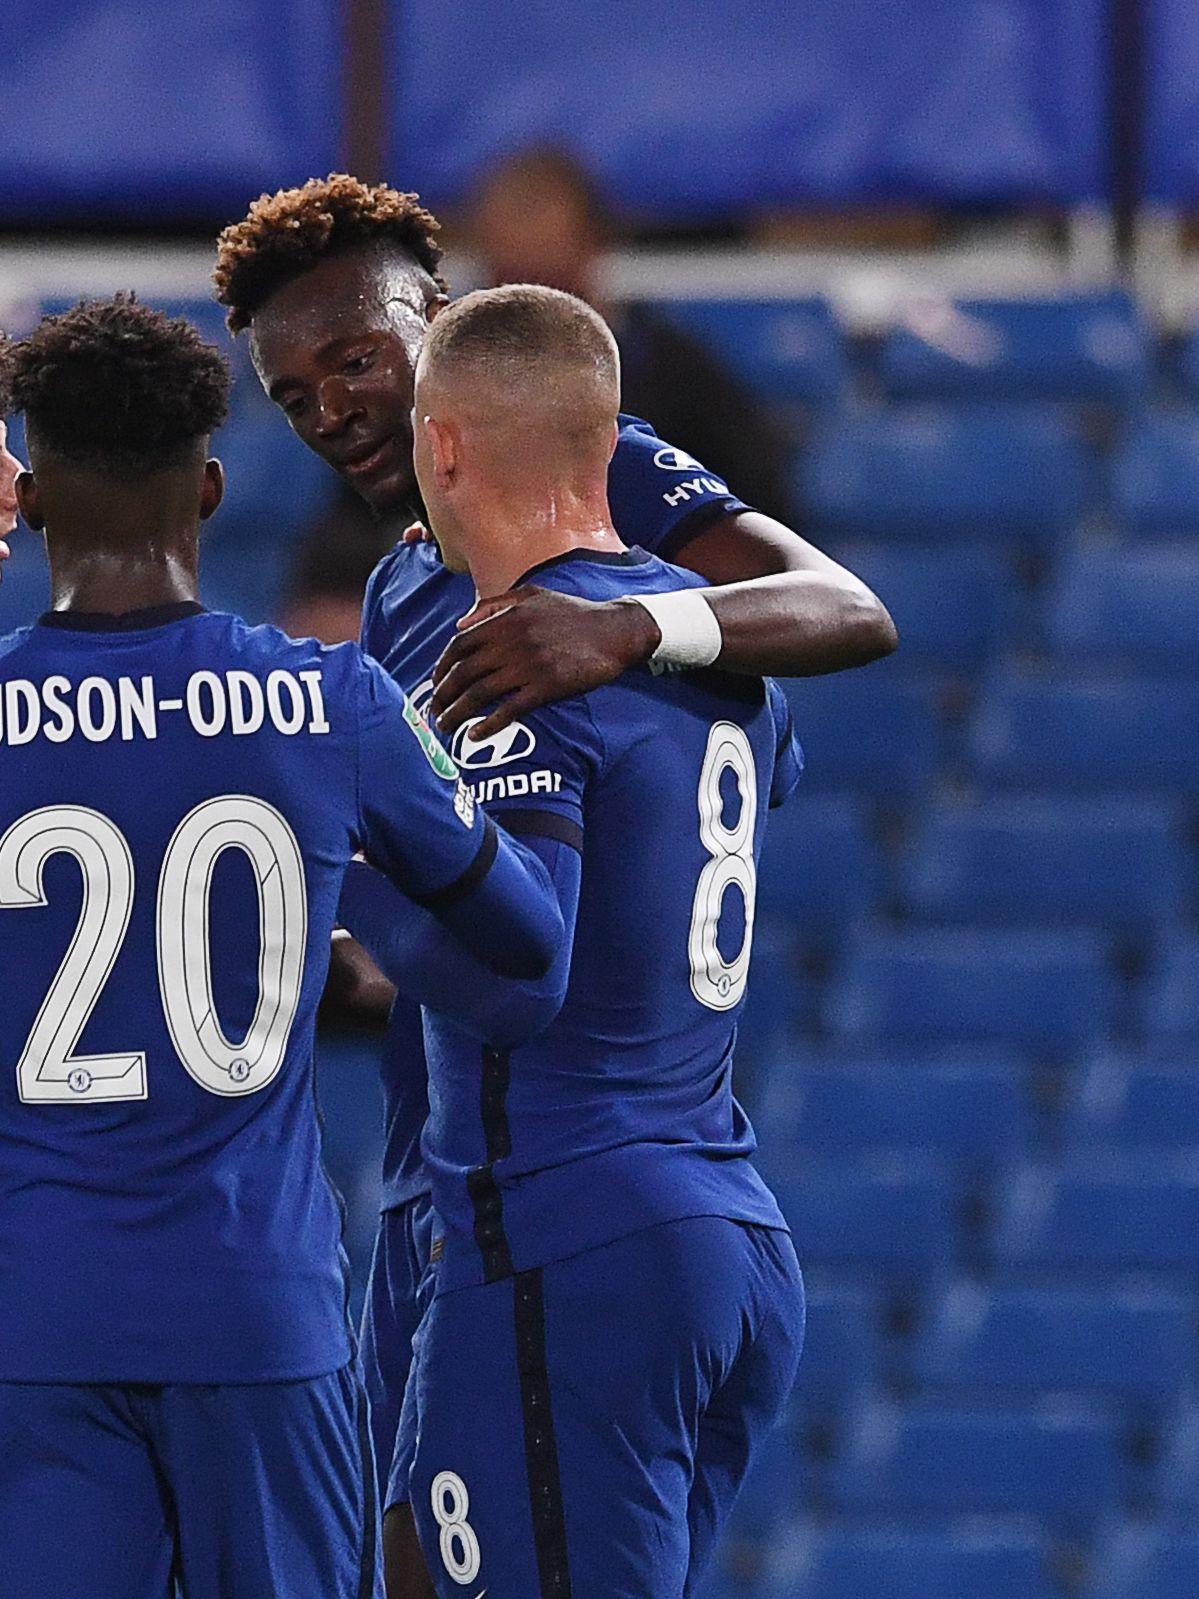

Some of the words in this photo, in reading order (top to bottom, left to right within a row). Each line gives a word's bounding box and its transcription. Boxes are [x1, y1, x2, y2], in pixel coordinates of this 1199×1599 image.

[471, 769, 562, 804] UNDAI
[687, 720, 758, 1012] 8
[430, 1470, 481, 1585] 8
